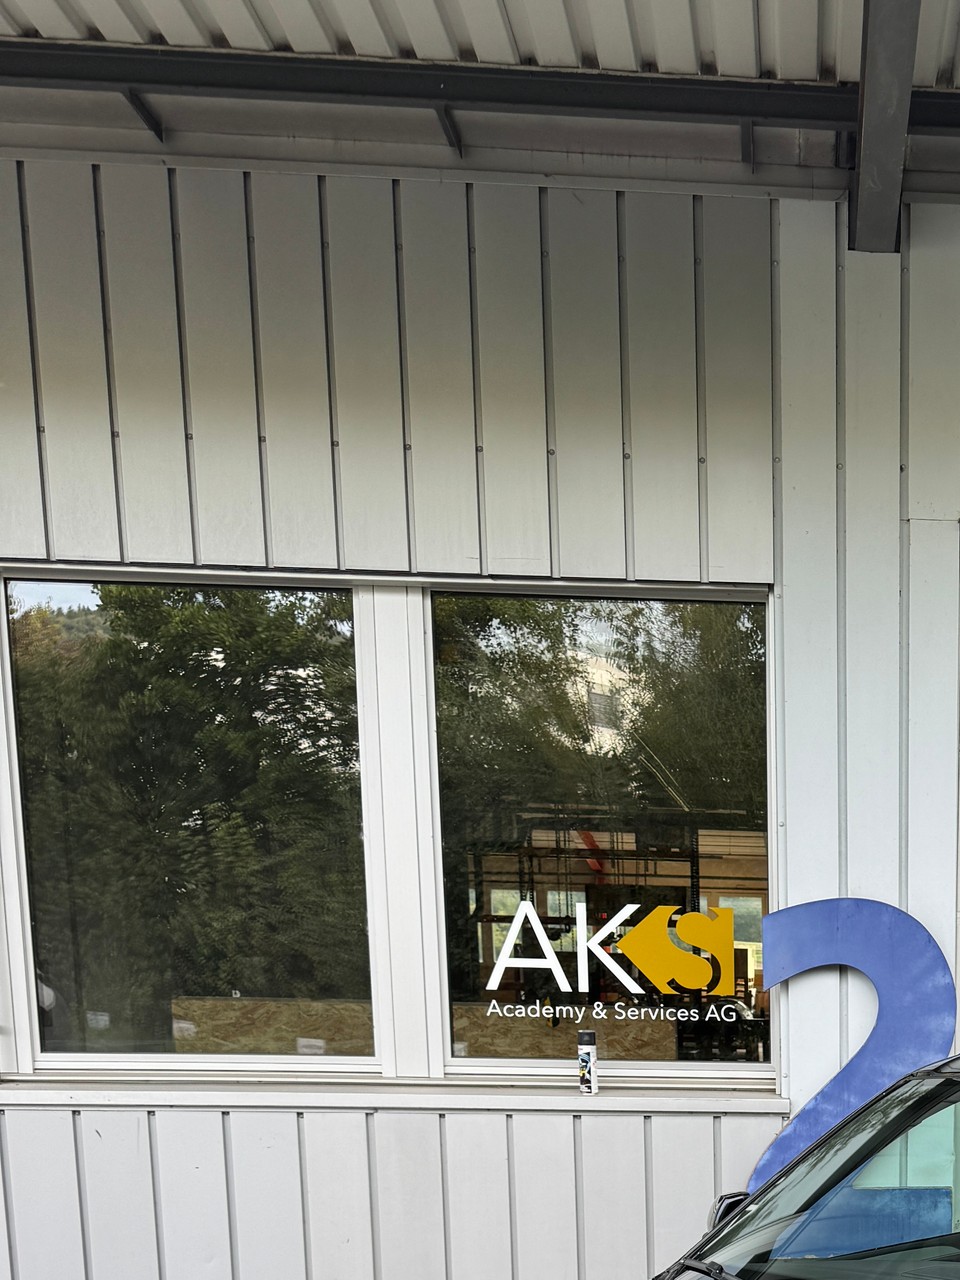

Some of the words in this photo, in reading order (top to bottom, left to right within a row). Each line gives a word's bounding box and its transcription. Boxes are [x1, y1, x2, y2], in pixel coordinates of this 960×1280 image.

[485, 900, 735, 996] AKS
[486, 999, 586, 1024] Academy
[592, 1001, 608, 1020] &
[614, 1002, 700, 1022] Services
[704, 1004, 737, 1023] AG
[746, 896, 957, 1259] 2
